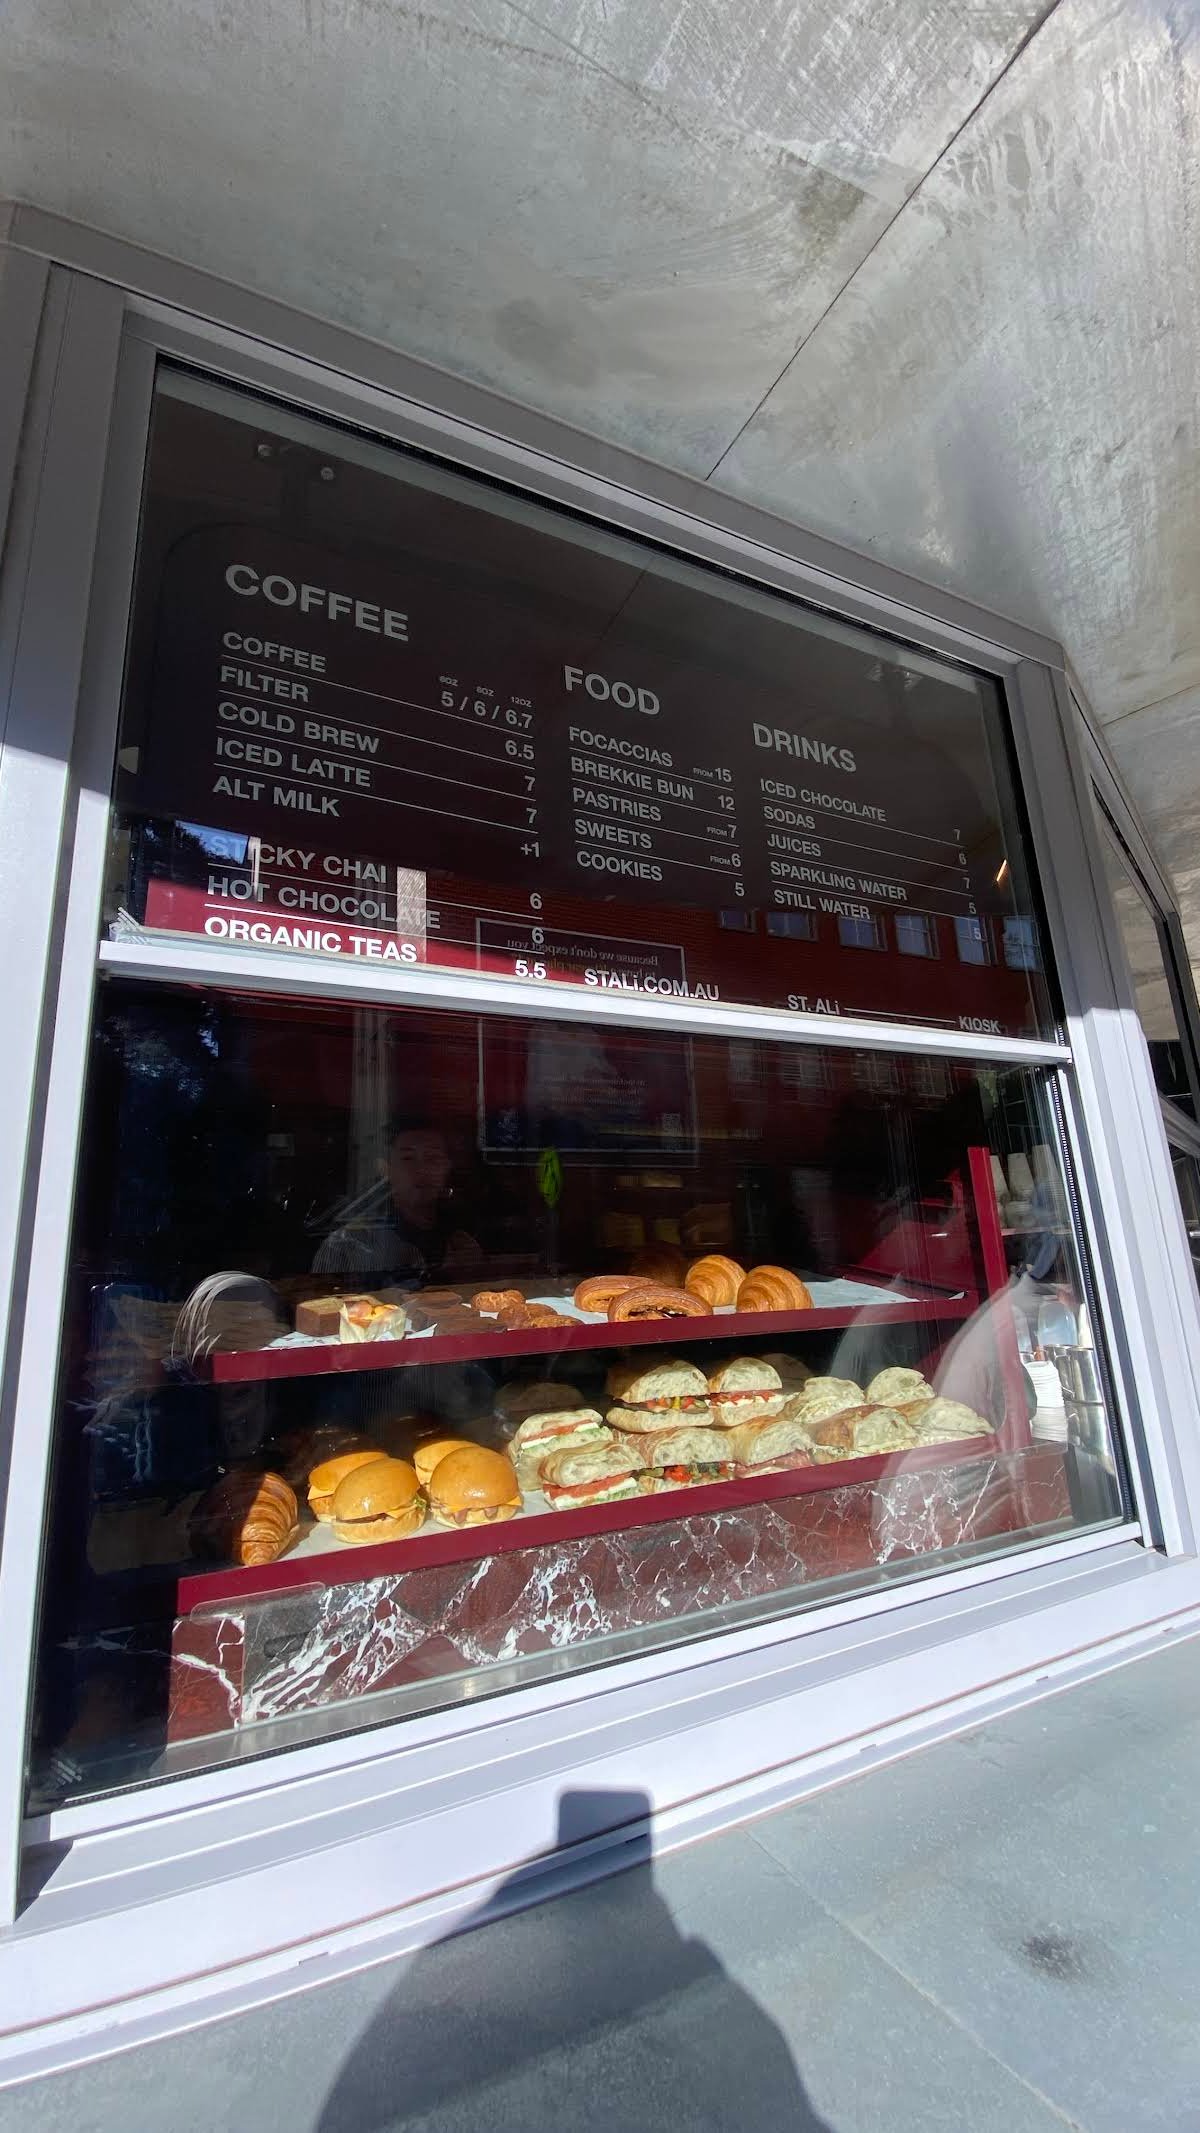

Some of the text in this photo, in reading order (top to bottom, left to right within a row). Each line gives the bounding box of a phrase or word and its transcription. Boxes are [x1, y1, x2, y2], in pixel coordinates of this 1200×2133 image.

[225, 564, 409, 642] COFFEE
[222, 631, 327, 673] COFFEE
[441, 690, 454, 707] 5
[474, 700, 486, 717] 6
[505, 709, 533, 729] 6.7
[564, 665, 660, 715] FOOD
[220, 665, 535, 760] FILTER 6.5
[218, 701, 536, 792] COLD BREW 7
[569, 725, 673, 767] FOCACCIAS
[714, 767, 732, 783] 15
[753, 722, 857, 773] DRINKS
[216, 737, 537, 824] ICED LATTE 7
[571, 756, 735, 811] BREKKIE BUN 12
[212, 775, 540, 858] ALT MILK +1
[572, 787, 662, 822] PASTRIES
[728, 824, 737, 839] 7
[760, 778, 961, 841] ICED CHOCOLATE 7
[763, 805, 816, 829] SODAS
[575, 818, 652, 849] SWEETS
[731, 853, 742, 868] 6
[767, 833, 971, 889] JUICES 7
[323, 856, 387, 884] CHAI
[529, 892, 543, 910] 6
[576, 850, 745, 897] COOKIES 5
[770, 860, 856, 891] SPARKLING
[858, 879, 908, 901] WATER
[207, 875, 270, 903] HOT
[531, 927, 545, 944] 6
[774, 889, 982, 940] STILL WATER 5
[204, 916, 342, 953] ORGANIC
[348, 935, 418, 962] TEAS
[514, 959, 547, 980] 5.5
[584, 968, 720, 1001] STALi.COM.AU
[787, 994, 840, 1016] ST. ALi
[958, 1016, 1001, 1034] KIOSK
